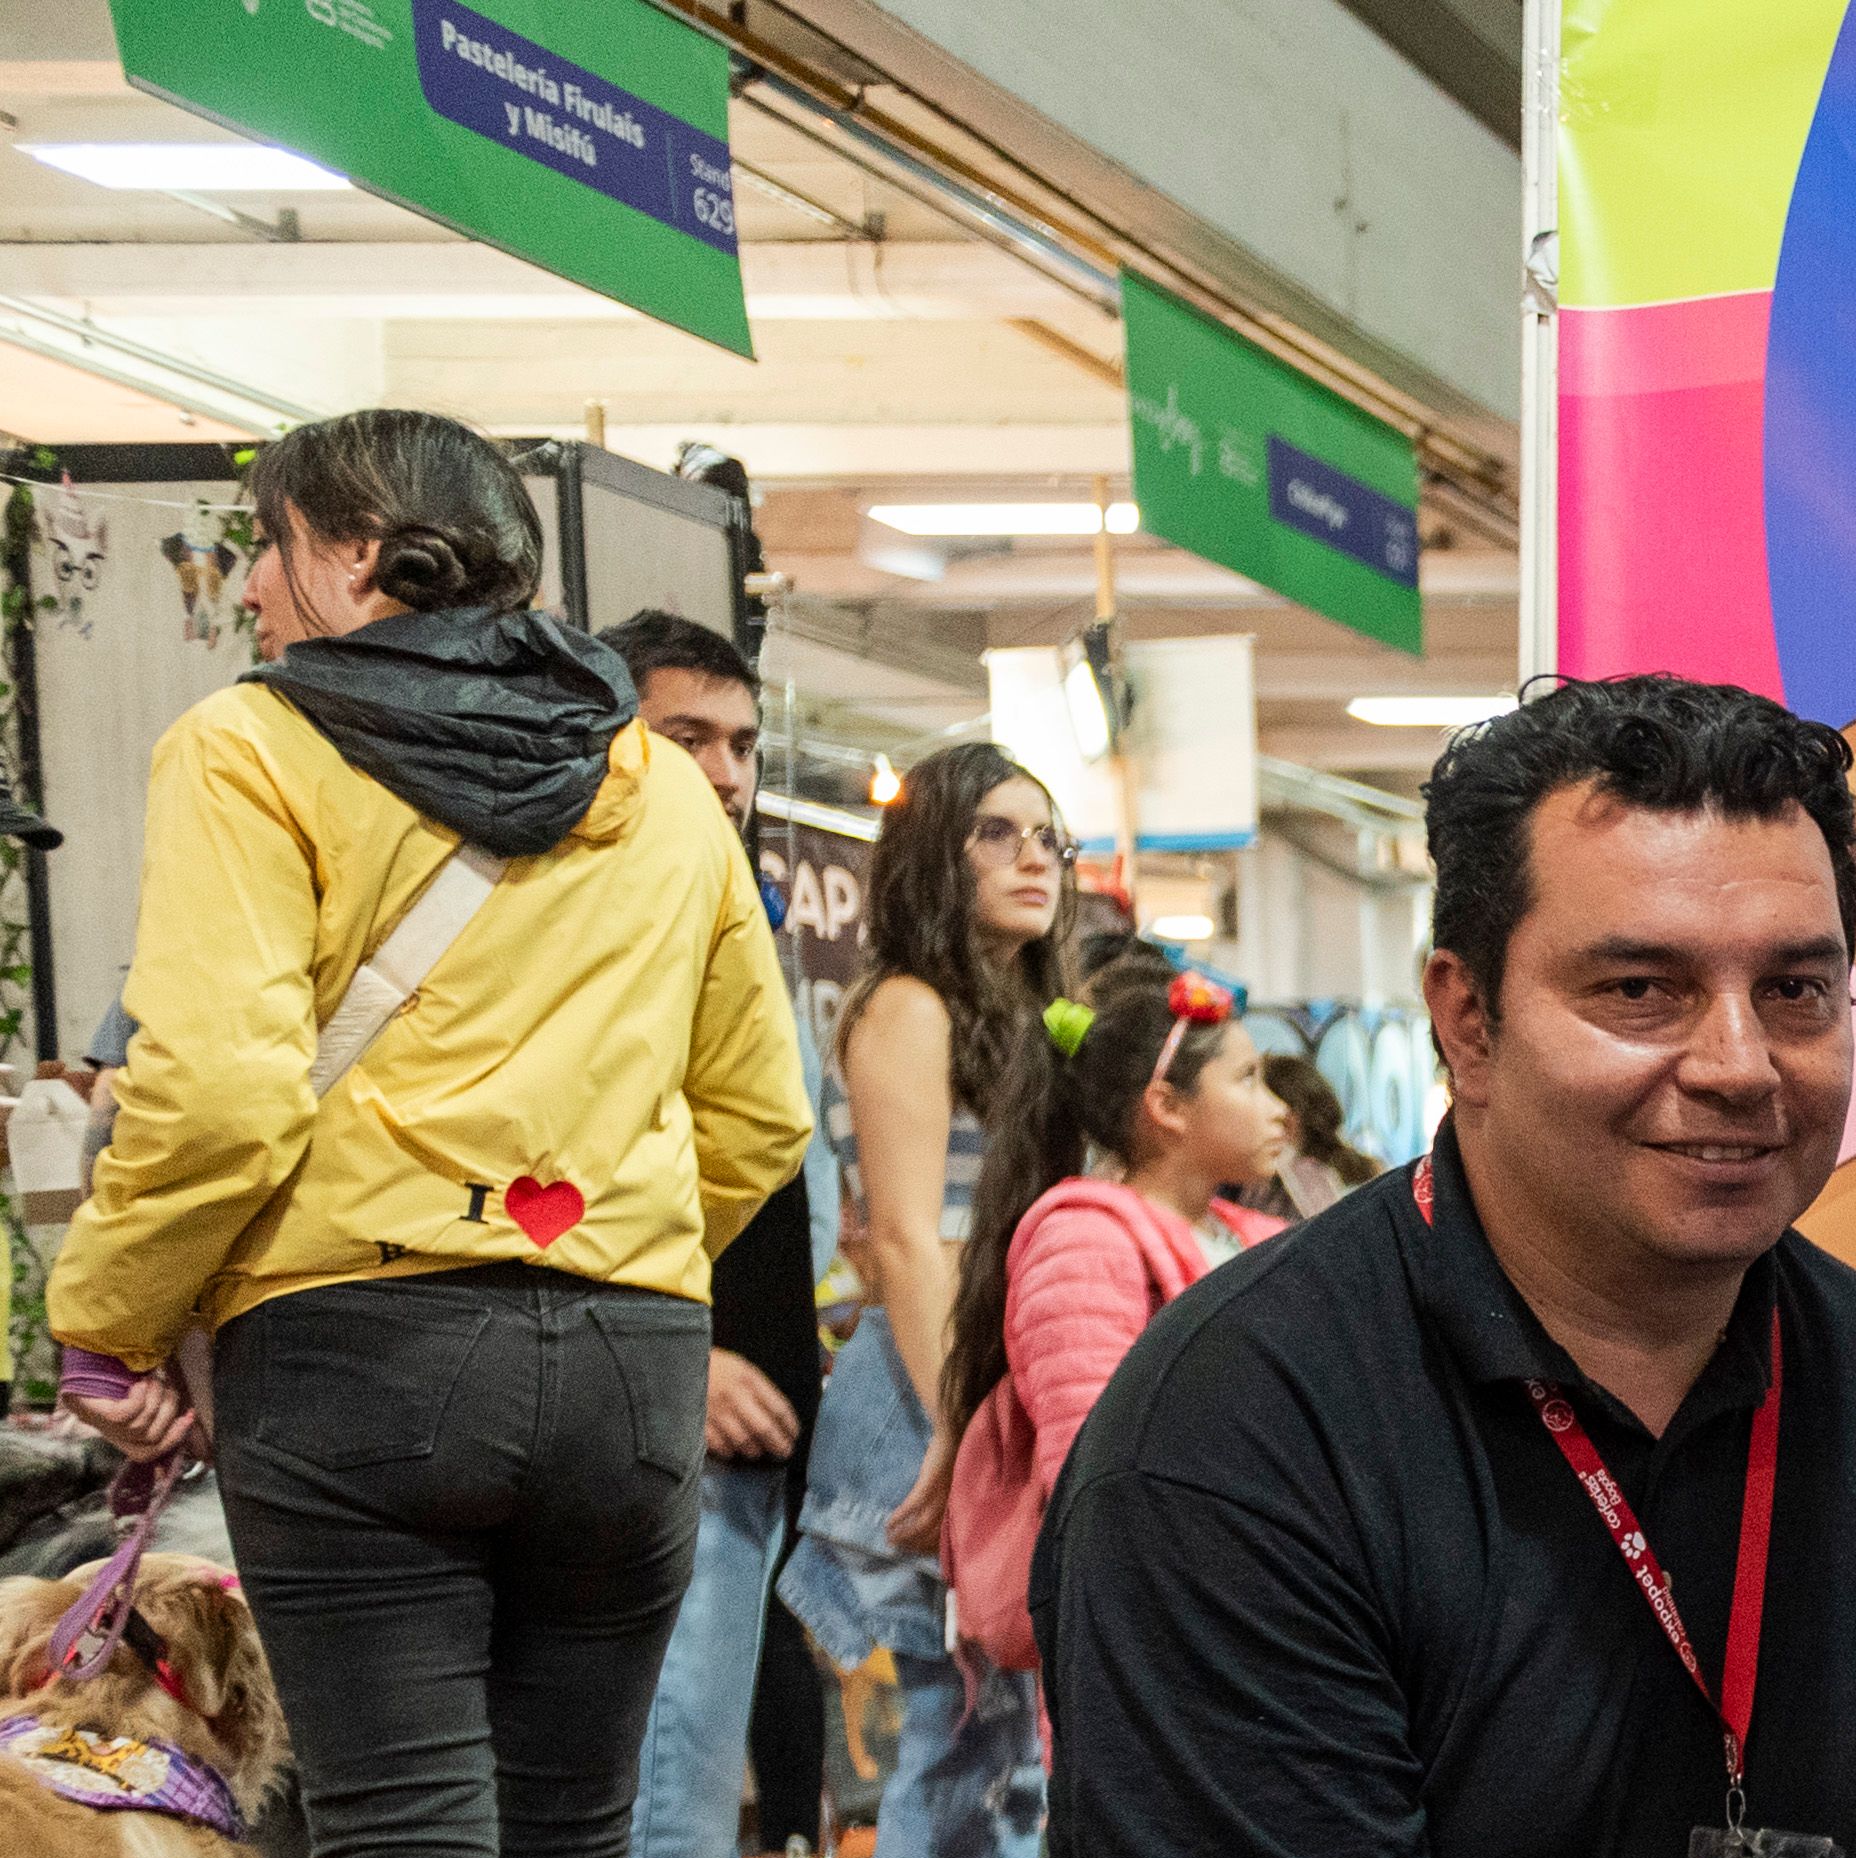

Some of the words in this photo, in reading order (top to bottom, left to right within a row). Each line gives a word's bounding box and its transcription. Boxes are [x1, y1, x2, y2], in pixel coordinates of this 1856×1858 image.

[441, 19, 561, 106] Pastelería
[504, 101, 521, 137] y
[523, 105, 598, 168] Misifú
[692, 186, 736, 236] 629
[460, 1181, 494, 1226] I
[1635, 1564, 1680, 1644] expopet
